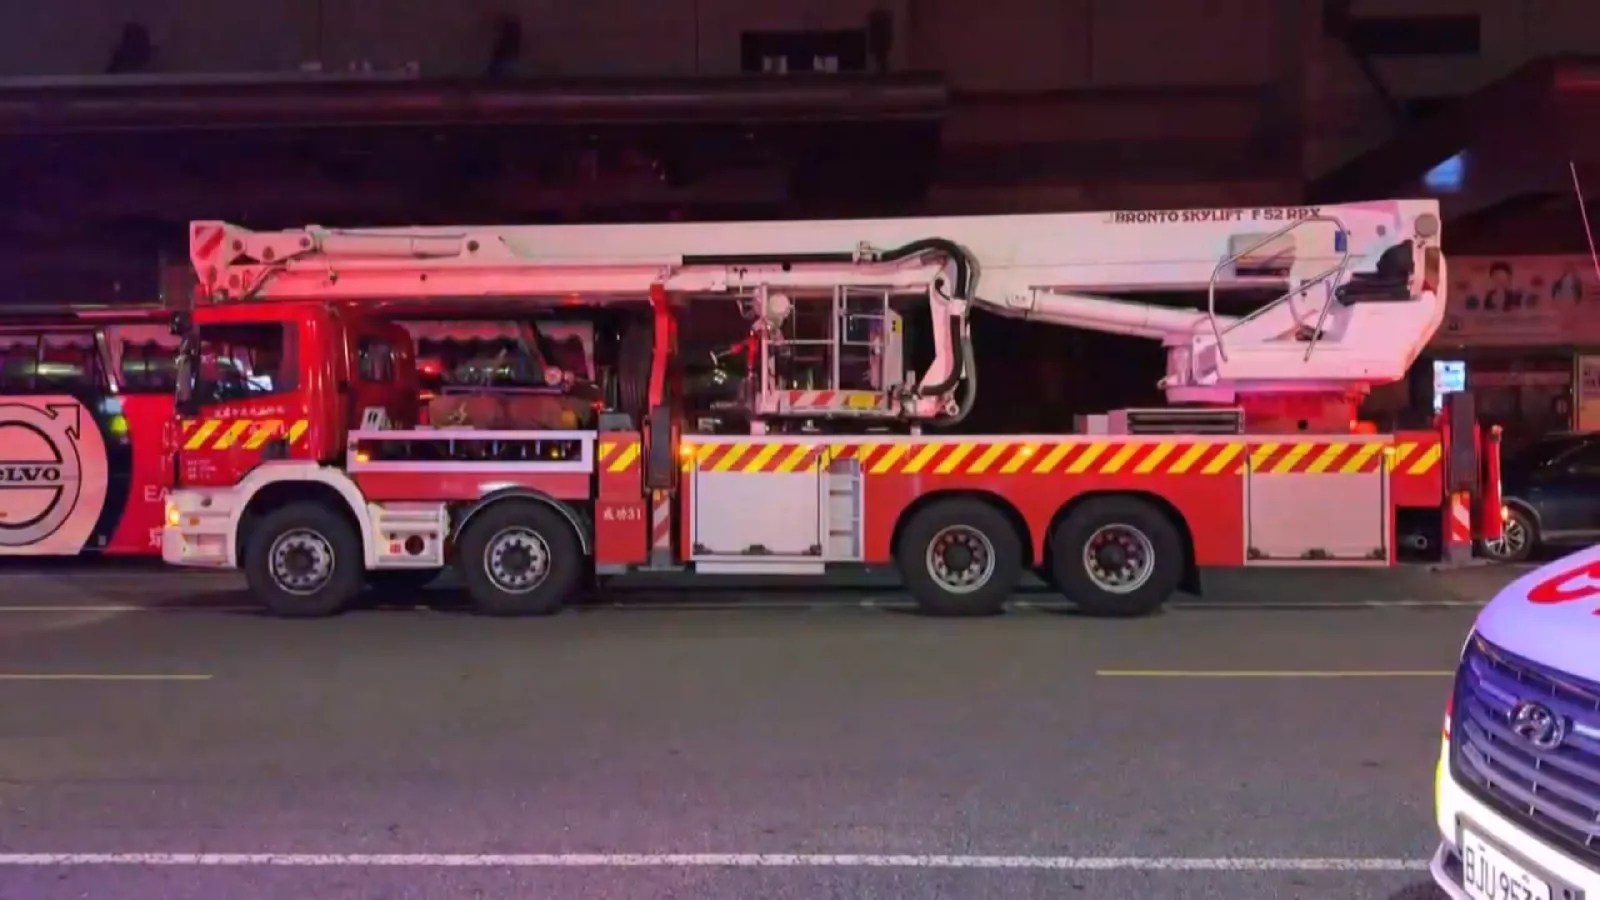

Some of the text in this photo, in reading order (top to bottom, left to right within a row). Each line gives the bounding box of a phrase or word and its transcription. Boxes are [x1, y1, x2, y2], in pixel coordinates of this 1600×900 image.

[1115, 210, 1179, 224] BRONTO
[1182, 209, 1243, 222] SKYLIFT
[1252, 208, 1261, 220] F
[1264, 208, 1283, 220] 52
